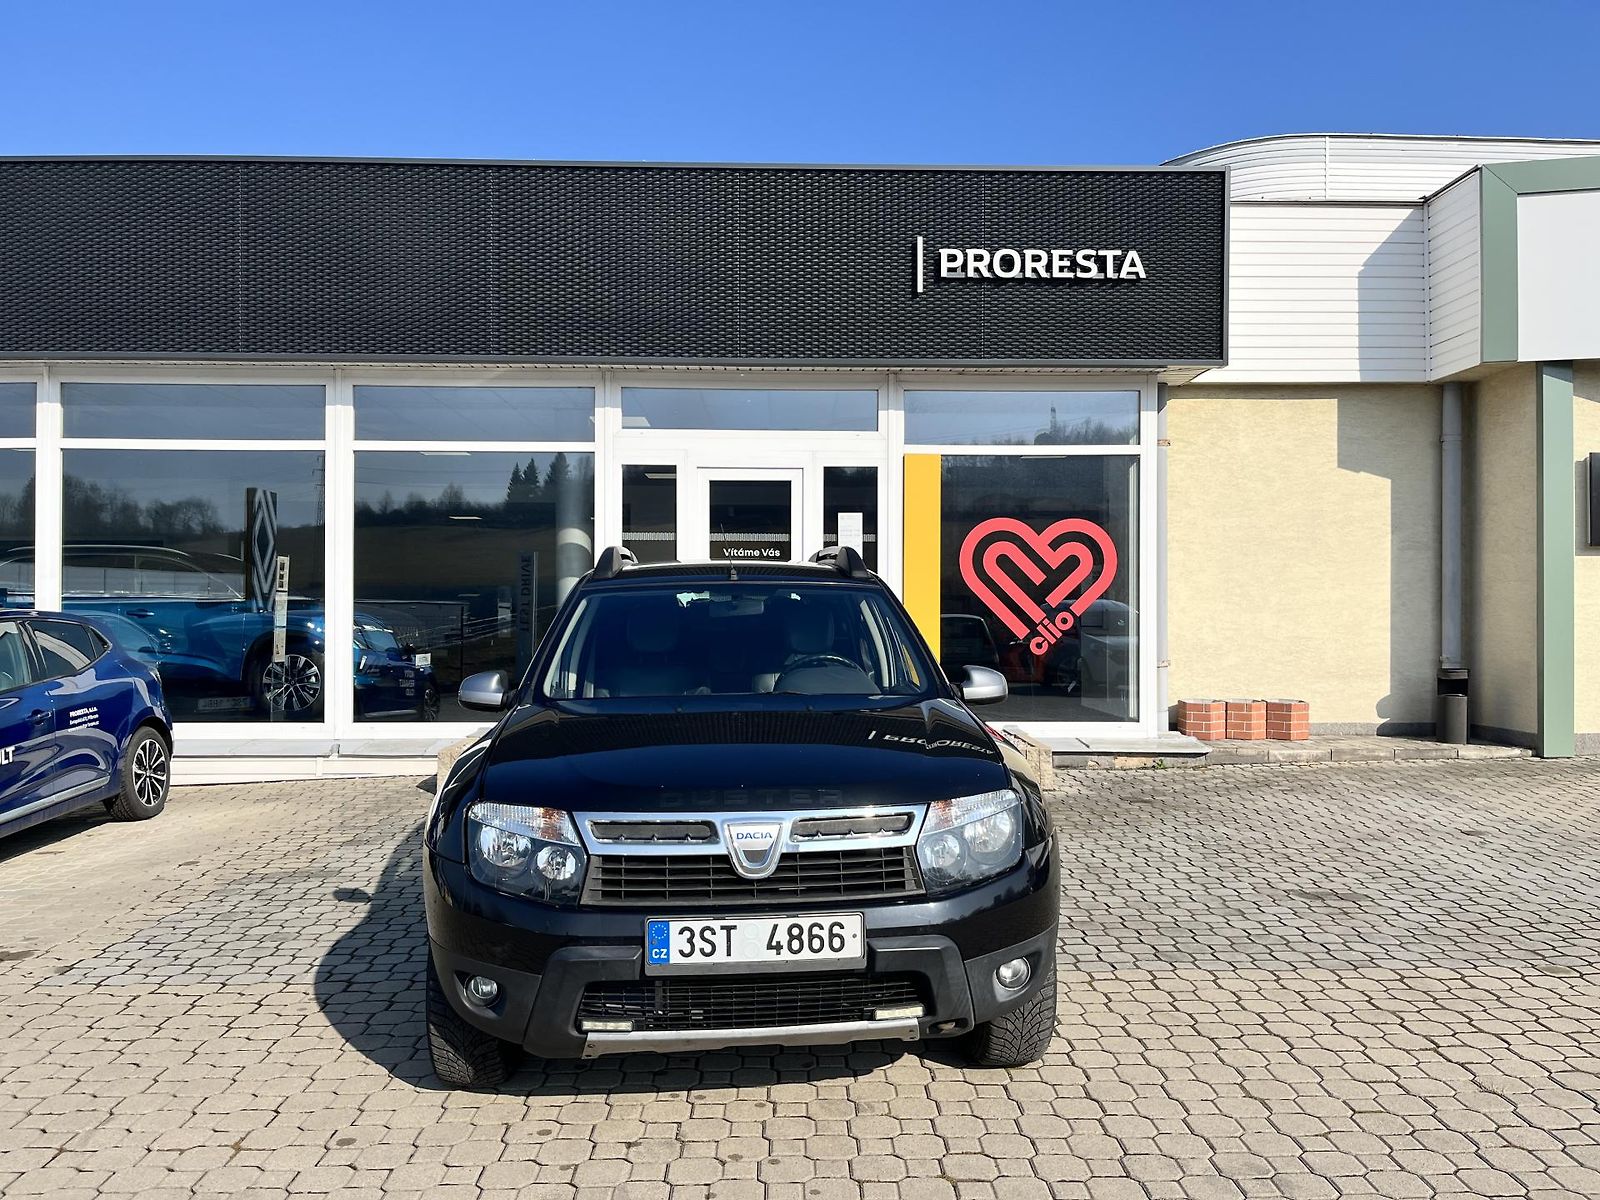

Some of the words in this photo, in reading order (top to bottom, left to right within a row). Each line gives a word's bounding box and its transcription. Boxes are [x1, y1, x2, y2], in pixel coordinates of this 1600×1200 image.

[938, 248, 1147, 279] PRORESTA
[723, 547, 760, 557] Vítáme
[761, 547, 781, 557] Vás
[1030, 611, 1074, 656] clio
[736, 831, 773, 841] DACIA
[678, 925, 738, 958] 3ST
[766, 921, 846, 956] 4866
[651, 948, 668, 959] CZ
